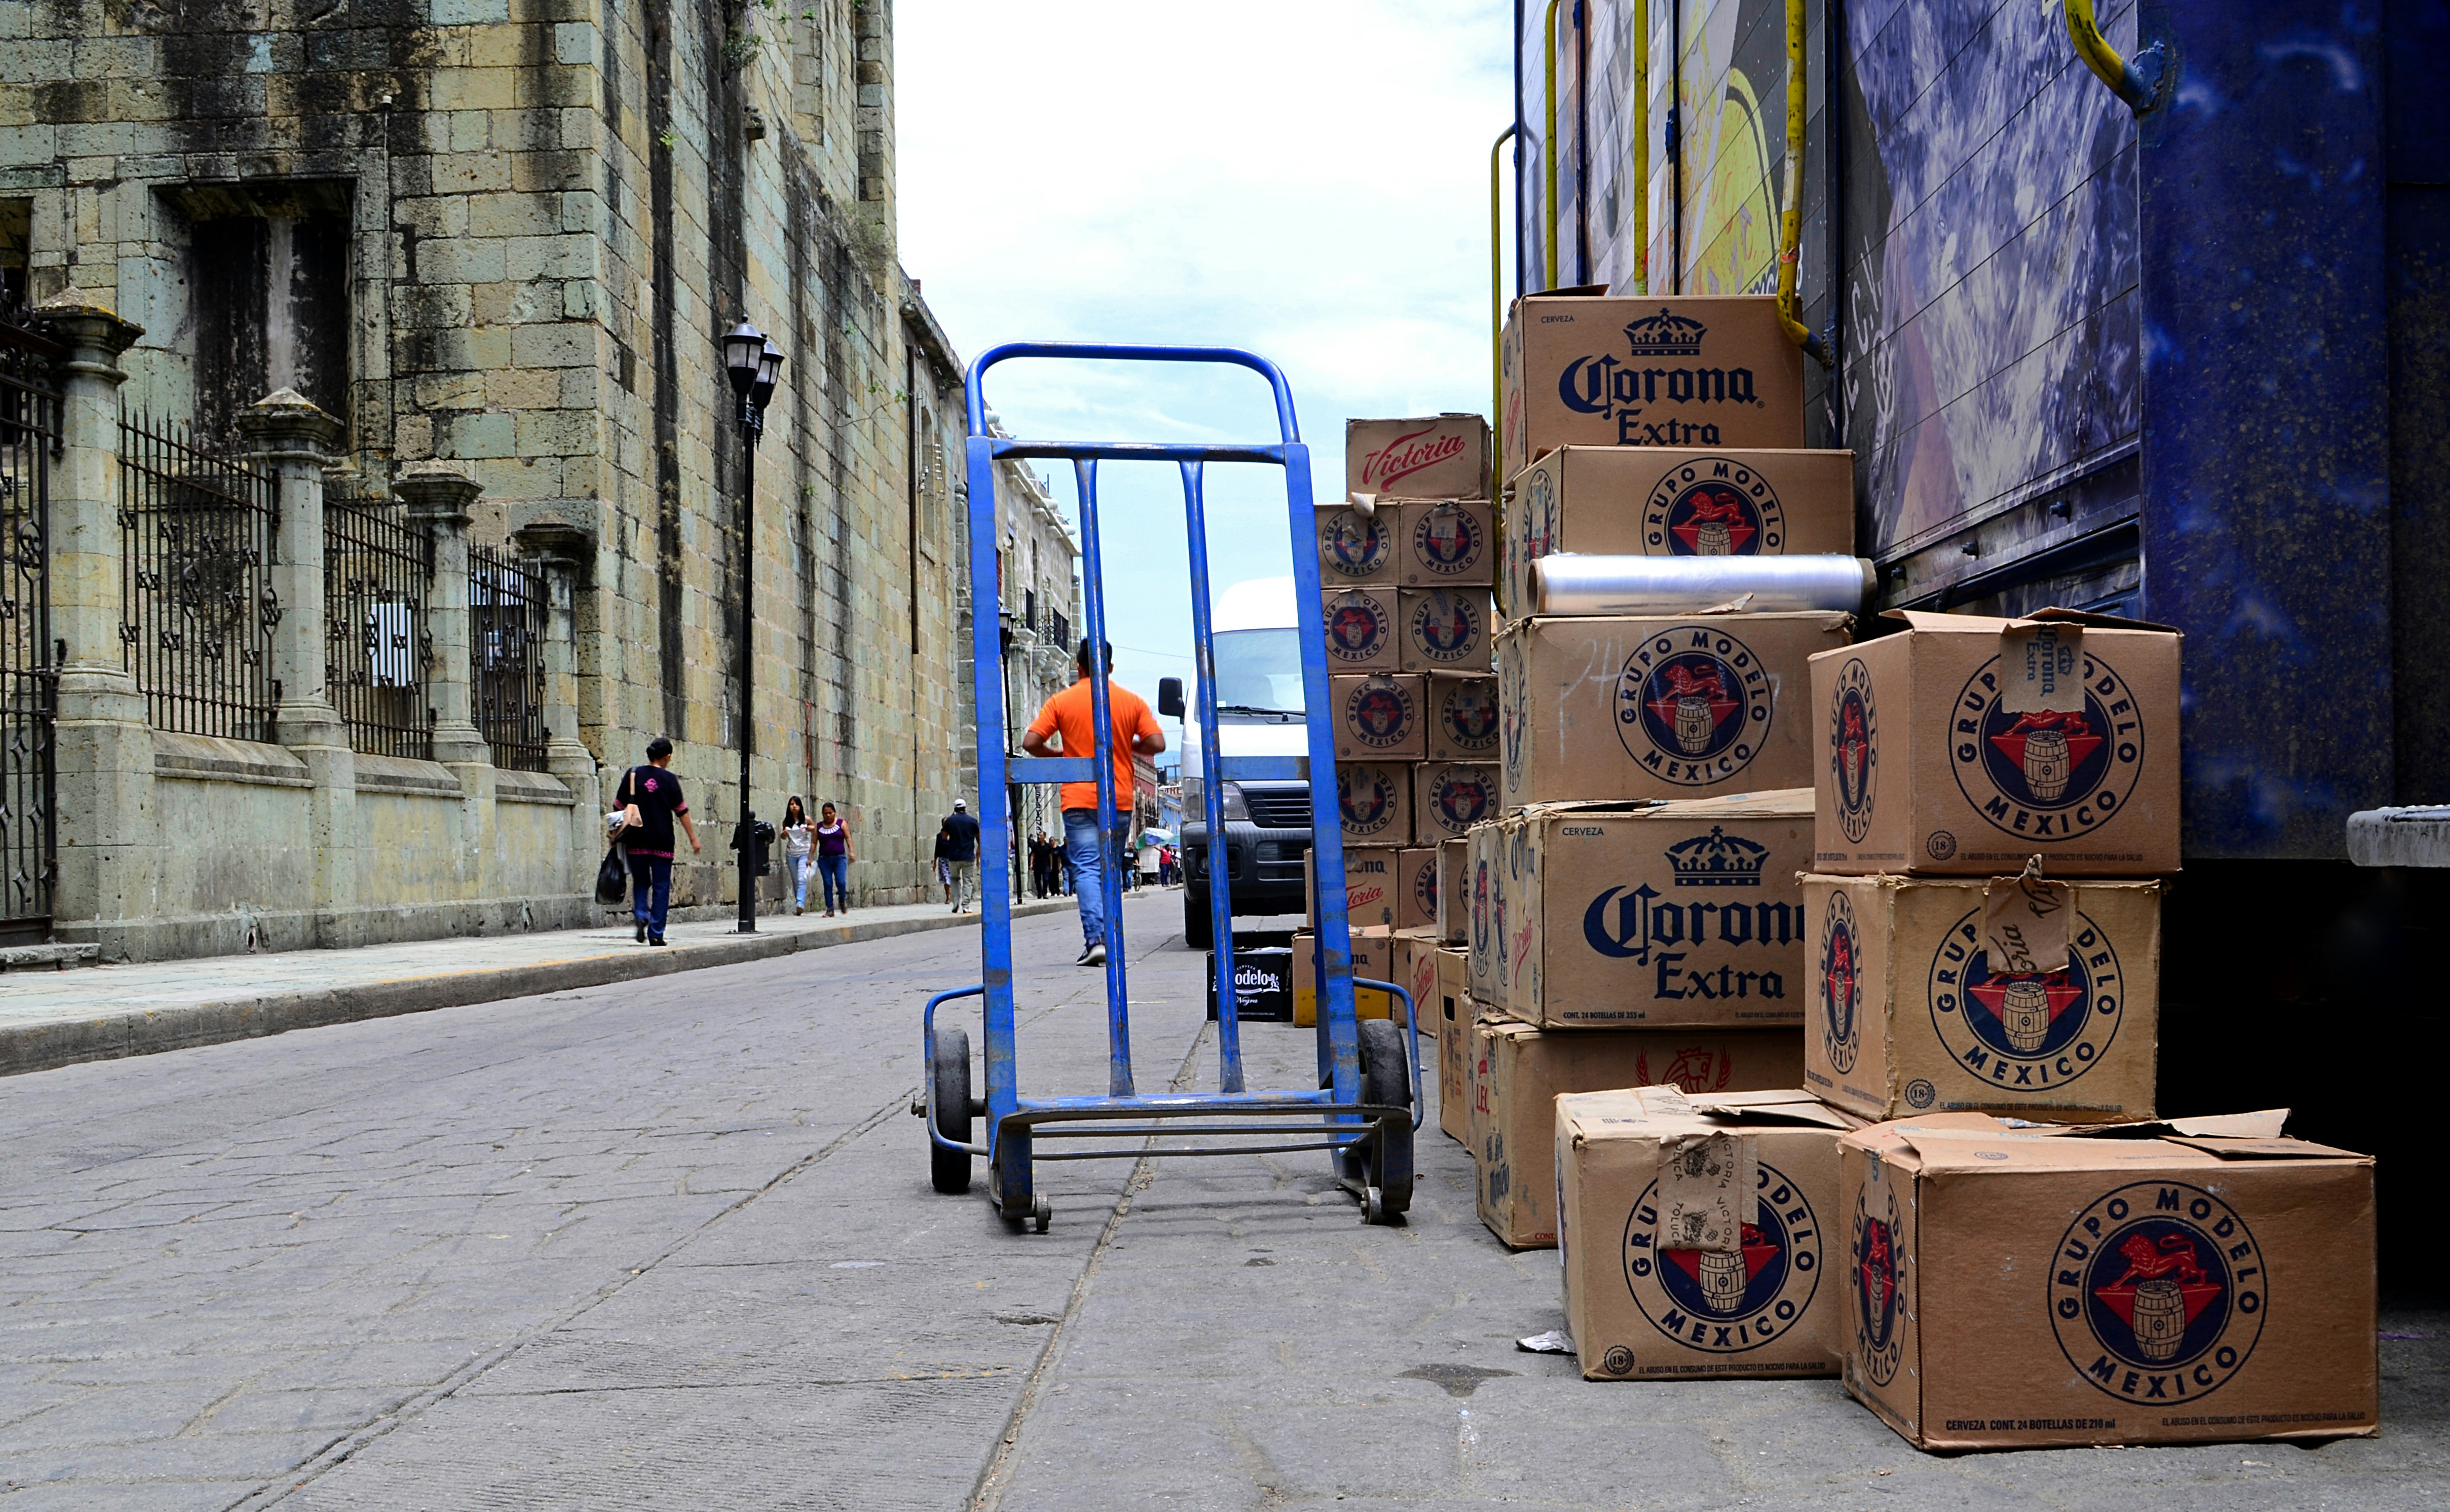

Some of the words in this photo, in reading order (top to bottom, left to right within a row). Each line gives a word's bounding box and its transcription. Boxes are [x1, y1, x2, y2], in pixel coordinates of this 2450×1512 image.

[1541, 315, 1575, 324] CERVEZA
[1559, 353, 1759, 420] Corona
[1616, 408, 1722, 446] Extra
[1362, 423, 1465, 493] Victoria
[1648, 467, 1695, 546] GRUPO
[1713, 462, 1780, 548] MODELO
[1325, 515, 1342, 550] GRUP
[1367, 517, 1388, 549] DELO
[1416, 516, 1430, 548] GRUP
[1457, 511, 1480, 547] ODELO
[1524, 486, 1534, 564] GRUP
[1336, 558, 1381, 575] MEXICO
[1426, 556, 1472, 572] MEXICO
[1324, 604, 1337, 636] GRUP
[1363, 598, 1387, 634] ODELO
[1414, 603, 1429, 635] GRUP
[1456, 599, 1479, 634] ODELO
[1333, 643, 1379, 660] MEXICO
[1425, 644, 1471, 660] MEXICO
[1619, 638, 1673, 724] GRUPO
[1691, 631, 1767, 722] MODELO
[1390, 685, 1412, 720] ODELO
[1444, 693, 1457, 723] GRUP
[1831, 673, 1846, 773] GRUPO
[1852, 664, 1876, 768] MODELO
[1958, 672, 1997, 763] GRUP
[2084, 659, 2137, 763] ODELO
[1358, 730, 1406, 746] MEXICO
[1643, 743, 1750, 781] MEXICO
[1377, 772, 1394, 809] DELO
[1474, 772, 1495, 807] ODELO
[1341, 817, 1387, 834] MEXICO
[1562, 827, 1604, 836] CERVEZA
[1839, 793, 1872, 838] MEXICO
[1984, 790, 2117, 835] MEXICO
[1583, 883, 1805, 966] Coron
[1820, 909, 1836, 998] GRUPO
[1840, 901, 1861, 1006] MODELO
[1937, 923, 1977, 1014] GRUP
[2077, 928, 2116, 1016] DELO
[1235, 969, 1268, 985] odelo
[1654, 952, 1785, 1000] Extra
[1826, 1032, 1858, 1069] MEXICO
[1963, 1041, 2095, 1086] MEXICO
[1940, 1102, 1946, 1110] EL
[1947, 1102, 1965, 1110] ABUSO
[1966, 1102, 1973, 1110] EN
[1980, 1103, 2006, 1111] CONSUMO
[2007, 1103, 2013, 1111] DE
[2014, 1103, 2027, 1111] ESTE
[2028, 1103, 2055, 1111] PRODUCTO
[1717, 1138, 1734, 1189] ICTORIA
[1631, 1188, 1658, 1277] GRU
[1757, 1169, 1815, 1272] ODELO
[1671, 1202, 1685, 1247] TOLUCA
[1716, 1196, 1733, 1250] VICTORI
[1853, 1196, 1866, 1286] GRUP
[1888, 1194, 1905, 1316] ODELO
[2058, 1198, 2129, 1320] GRUPO
[2156, 1187, 2259, 1315] MODELO
[1660, 1299, 1796, 1347] MEXICO
[1639, 1367, 1646, 1375] EL
[1647, 1366, 1664, 1374] ABUSO
[1665, 1366, 1672, 1374] EN
[1680, 1365, 1706, 1373] CONSUMO
[1715, 1365, 1728, 1373] ESTE
[1729, 1364, 1756, 1372] PRODUCTO
[1757, 1364, 1764, 1372] ES
[1765, 1363, 1785, 1372] NOCIVO
[1786, 1362, 1799, 1371] PARA
[1800, 1362, 1807, 1371] LA
[1808, 1362, 1825, 1371] SALUD
[1859, 1327, 1897, 1379] MEXICO
[2088, 1345, 2237, 1398] MEXICO
[1946, 1420, 1986, 1431] CERVEZA
[1990, 1420, 2015, 1430] CONT.
[2017, 1419, 2028, 1430] 24
[2029, 1418, 2073, 1430] BOTELLAS
[2075, 1418, 2087, 1429] DE
[2089, 1418, 2103, 1429] 210
[2105, 1418, 2116, 1429] ml
[2162, 1418, 2170, 1426] EL
[2171, 1417, 2190, 1426] ABUSO
[2191, 1417, 2199, 1425] EN
[2200, 1416, 2206, 1425] EL
[2208, 1416, 2237, 1425] CONSUMO
[2238, 1415, 2246, 1424] DE
[2247, 1415, 2260, 1424] ESTE
[2261, 1414, 2291, 1423] PRODUCTO
[2292, 1414, 2299, 1423] ES
[2301, 1413, 2322, 1422] NOCIVO
[2323, 1413, 2337, 1421] PARA
[2339, 1412, 2346, 1421] LA
[2347, 1412, 2366, 1421] SALUD
